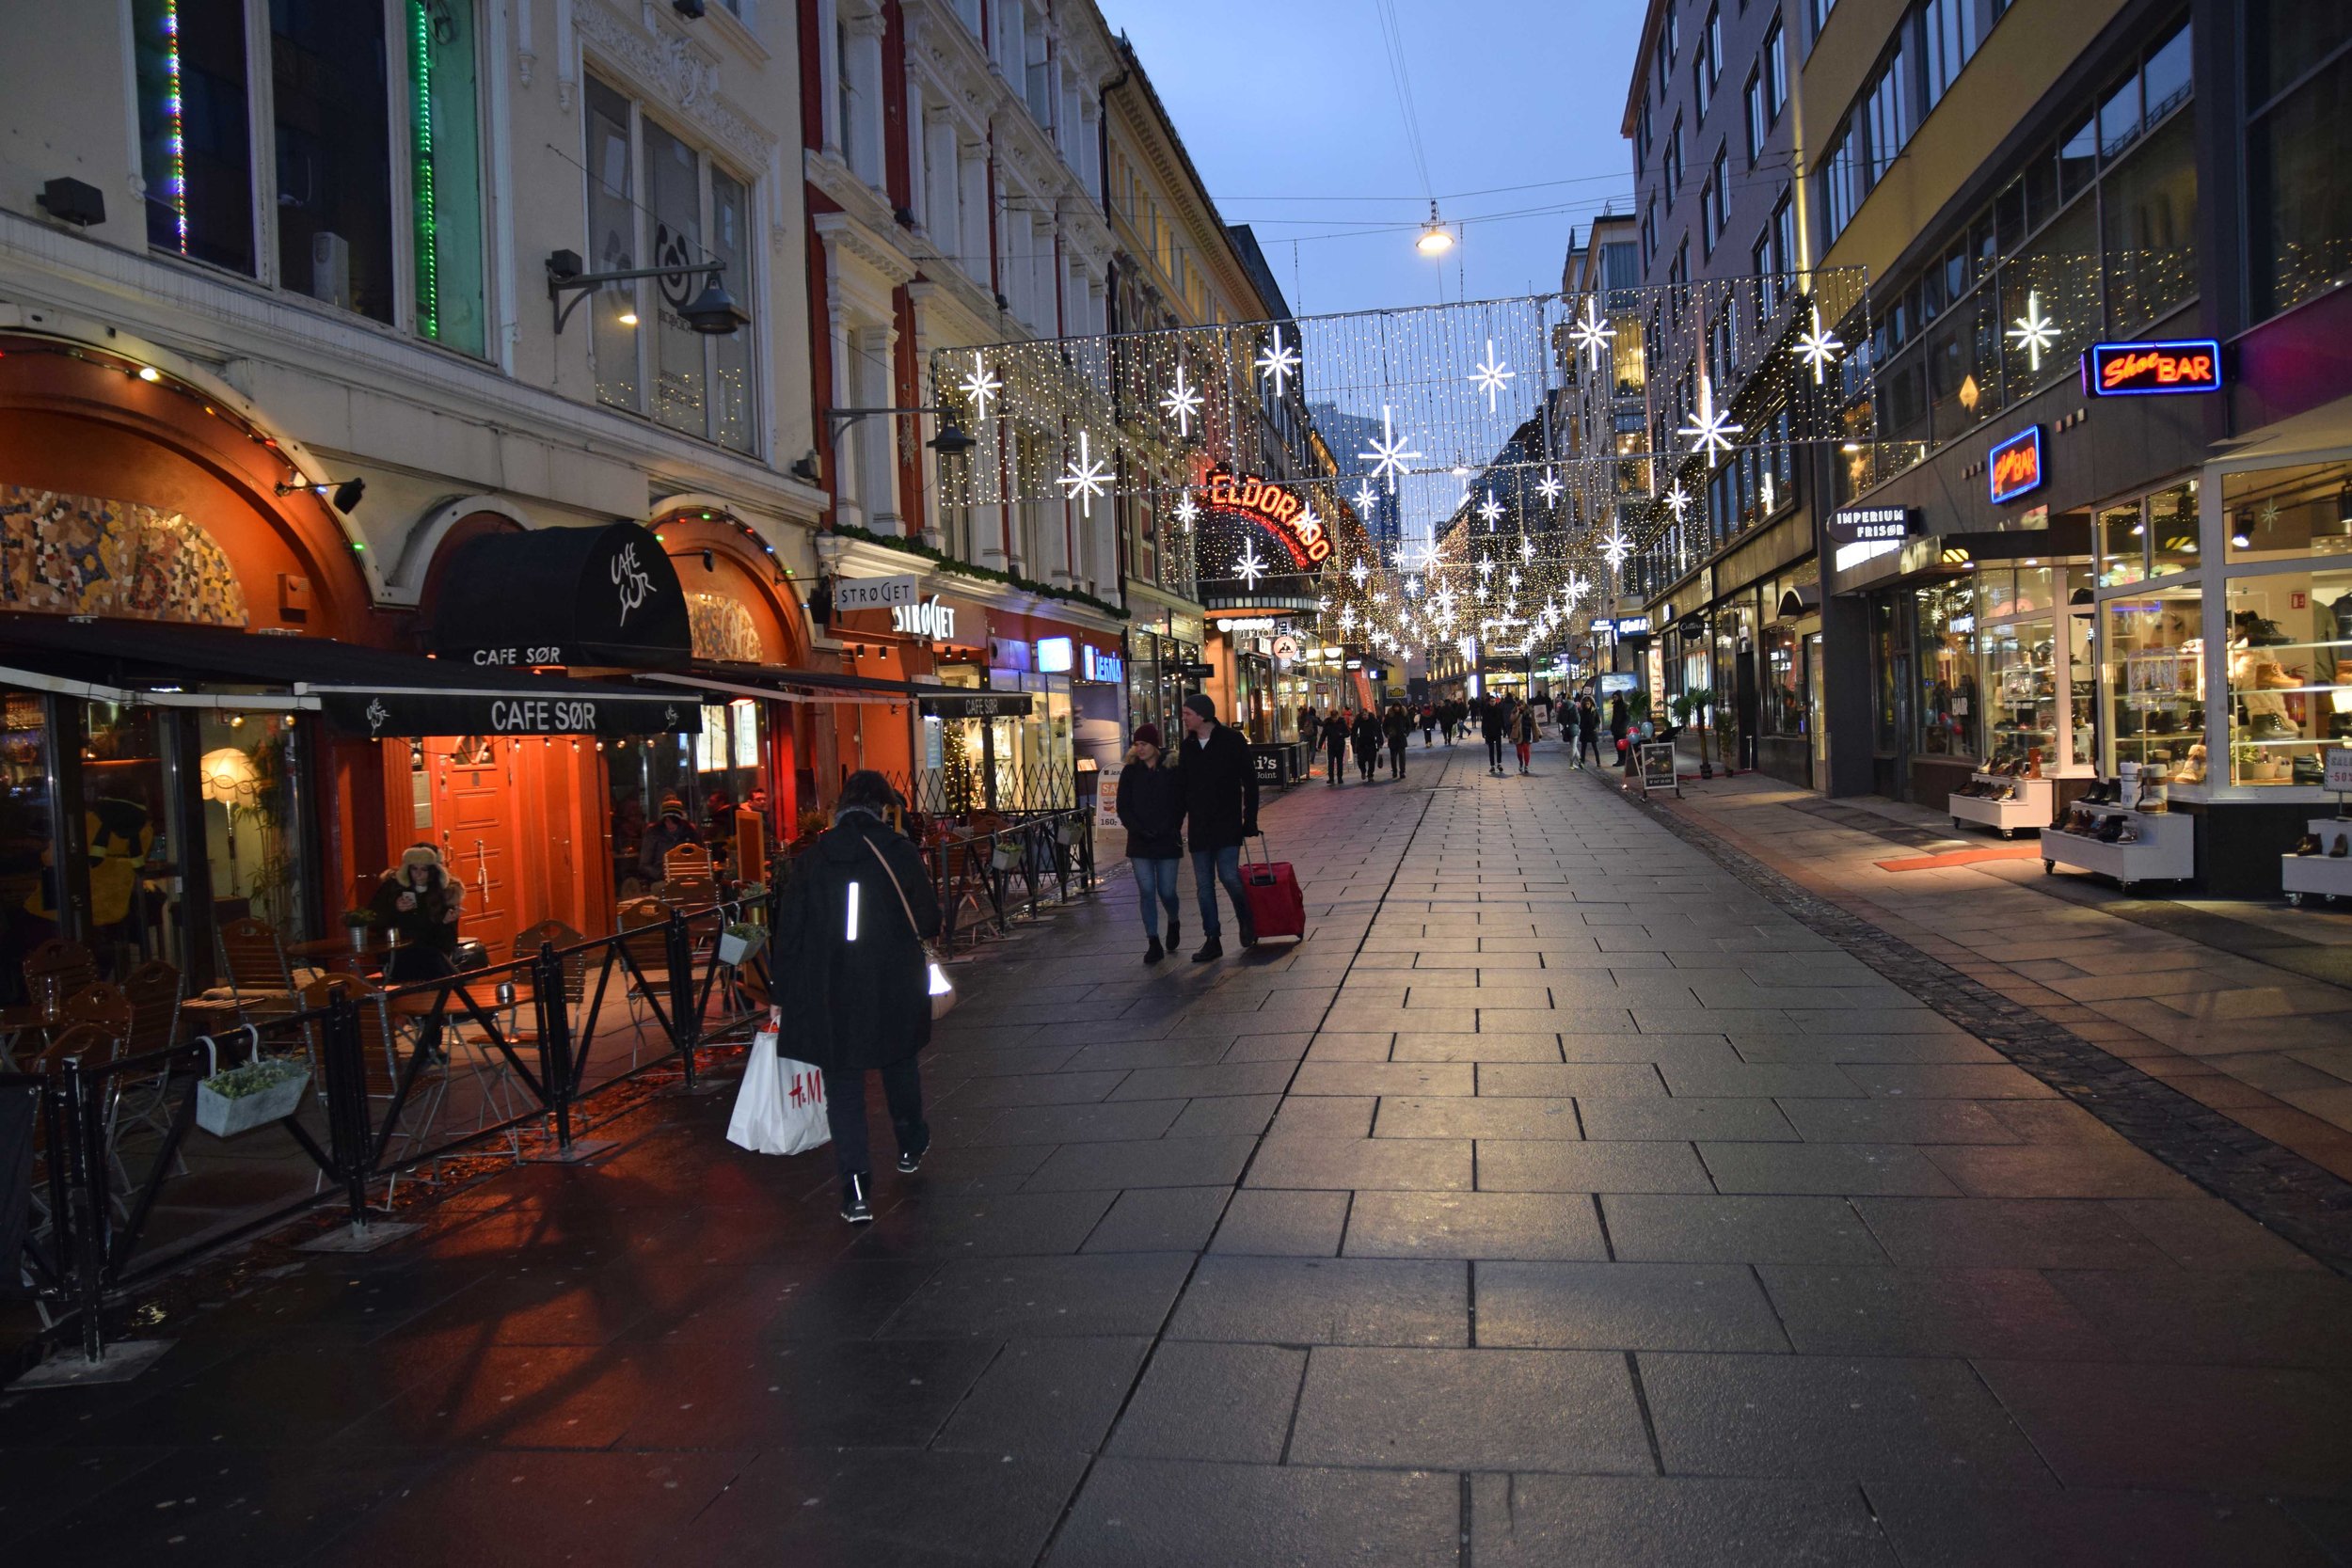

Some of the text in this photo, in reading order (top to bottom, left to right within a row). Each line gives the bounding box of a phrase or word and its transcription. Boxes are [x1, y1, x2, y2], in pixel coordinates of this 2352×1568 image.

[2104, 352, 2212, 388] Shoe BAR
[2010, 447, 2037, 483] BAR
[1212, 473, 1330, 562] ELDORADO
[1836, 509, 1904, 525] IMPERIUM
[1856, 524, 1905, 538] FRISØR
[841, 581, 910, 603] STRØGET
[892, 594, 955, 641] STRØGET
[473, 645, 561, 666] CAFE SØR
[490, 700, 596, 731] CAFE SØR
[965, 699, 998, 715] CAFE SØR
[1951, 697, 1969, 716] HAIR
[788, 1069, 822, 1109] H&M
